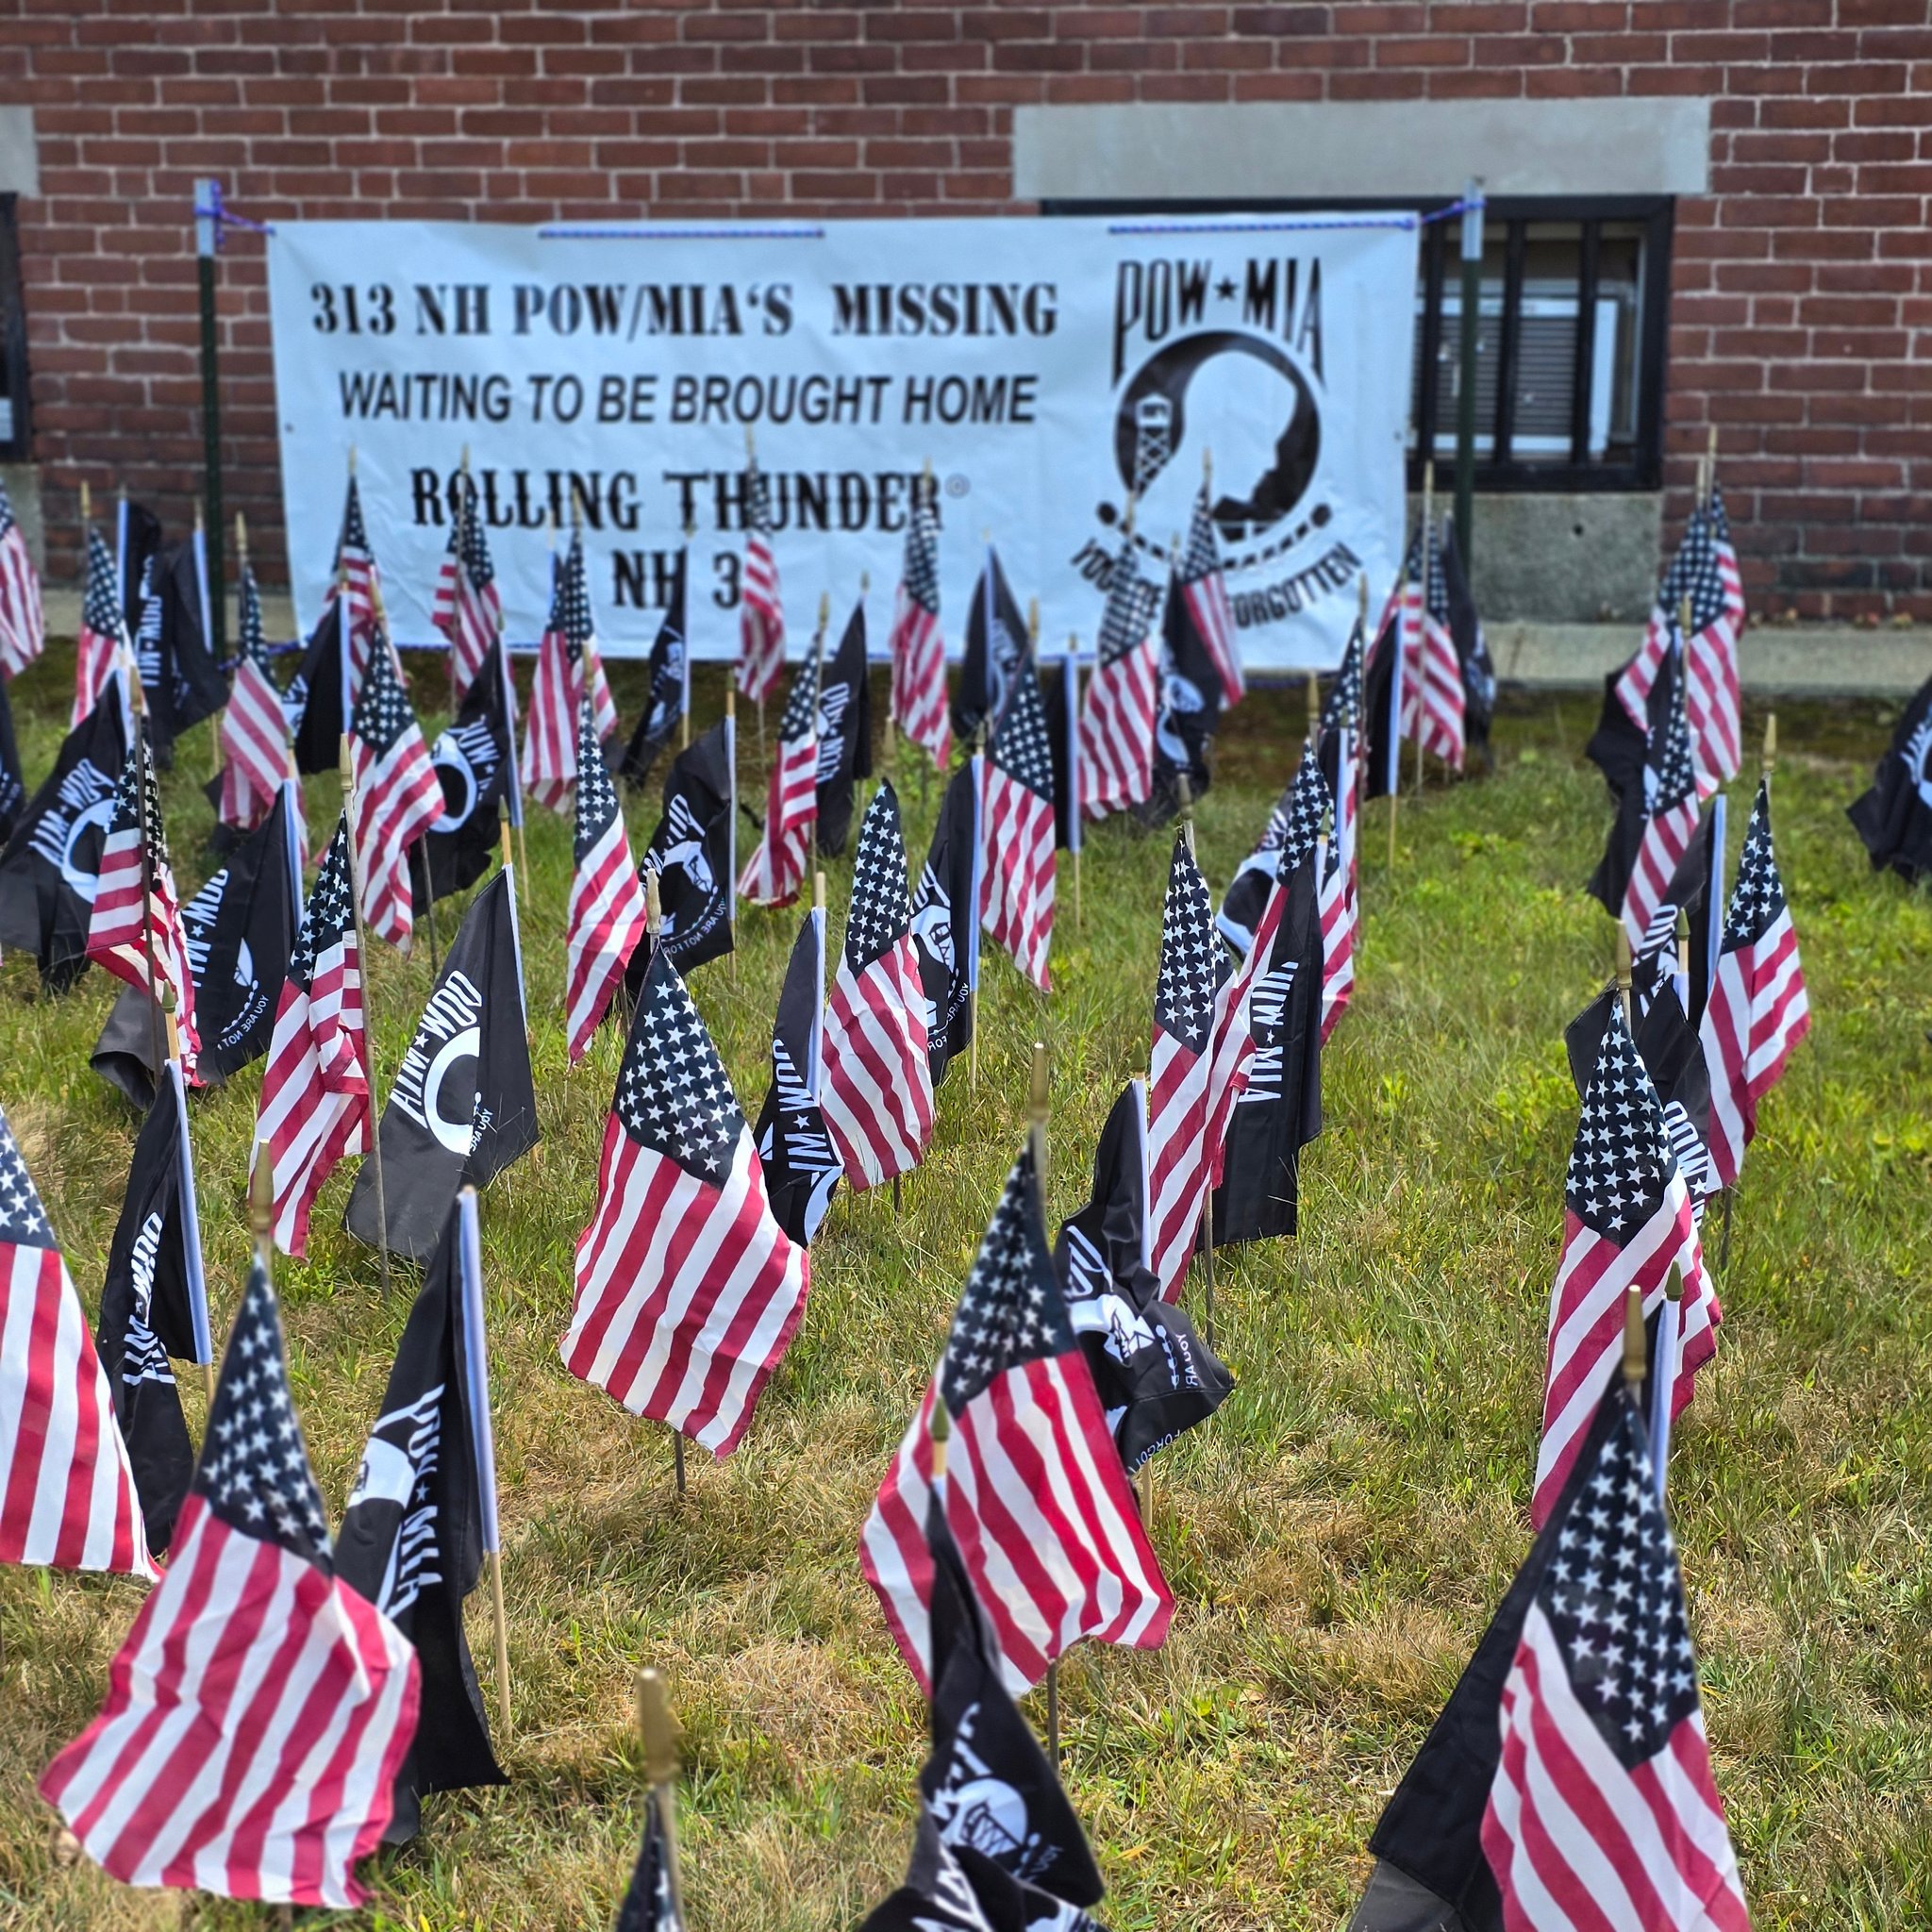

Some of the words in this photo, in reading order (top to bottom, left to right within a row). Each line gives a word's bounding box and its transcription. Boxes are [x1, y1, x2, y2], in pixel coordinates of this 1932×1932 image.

[310, 283, 396, 336] 313
[412, 284, 491, 336] NH
[831, 282, 1058, 337] MISSING
[1111, 258, 1211, 391] POW
[1242, 258, 1327, 392] MIA
[338, 371, 512, 422] WAITING
[527, 375, 584, 424] TO
[596, 375, 659, 425] BE
[670, 375, 893, 425] BROUGHT
[903, 374, 1041, 425] HOME
[410, 467, 643, 531] ROLLING
[611, 550, 686, 609] NH
[711, 551, 742, 609] 3
[1229, 541, 1363, 629] ORGOTTEN
